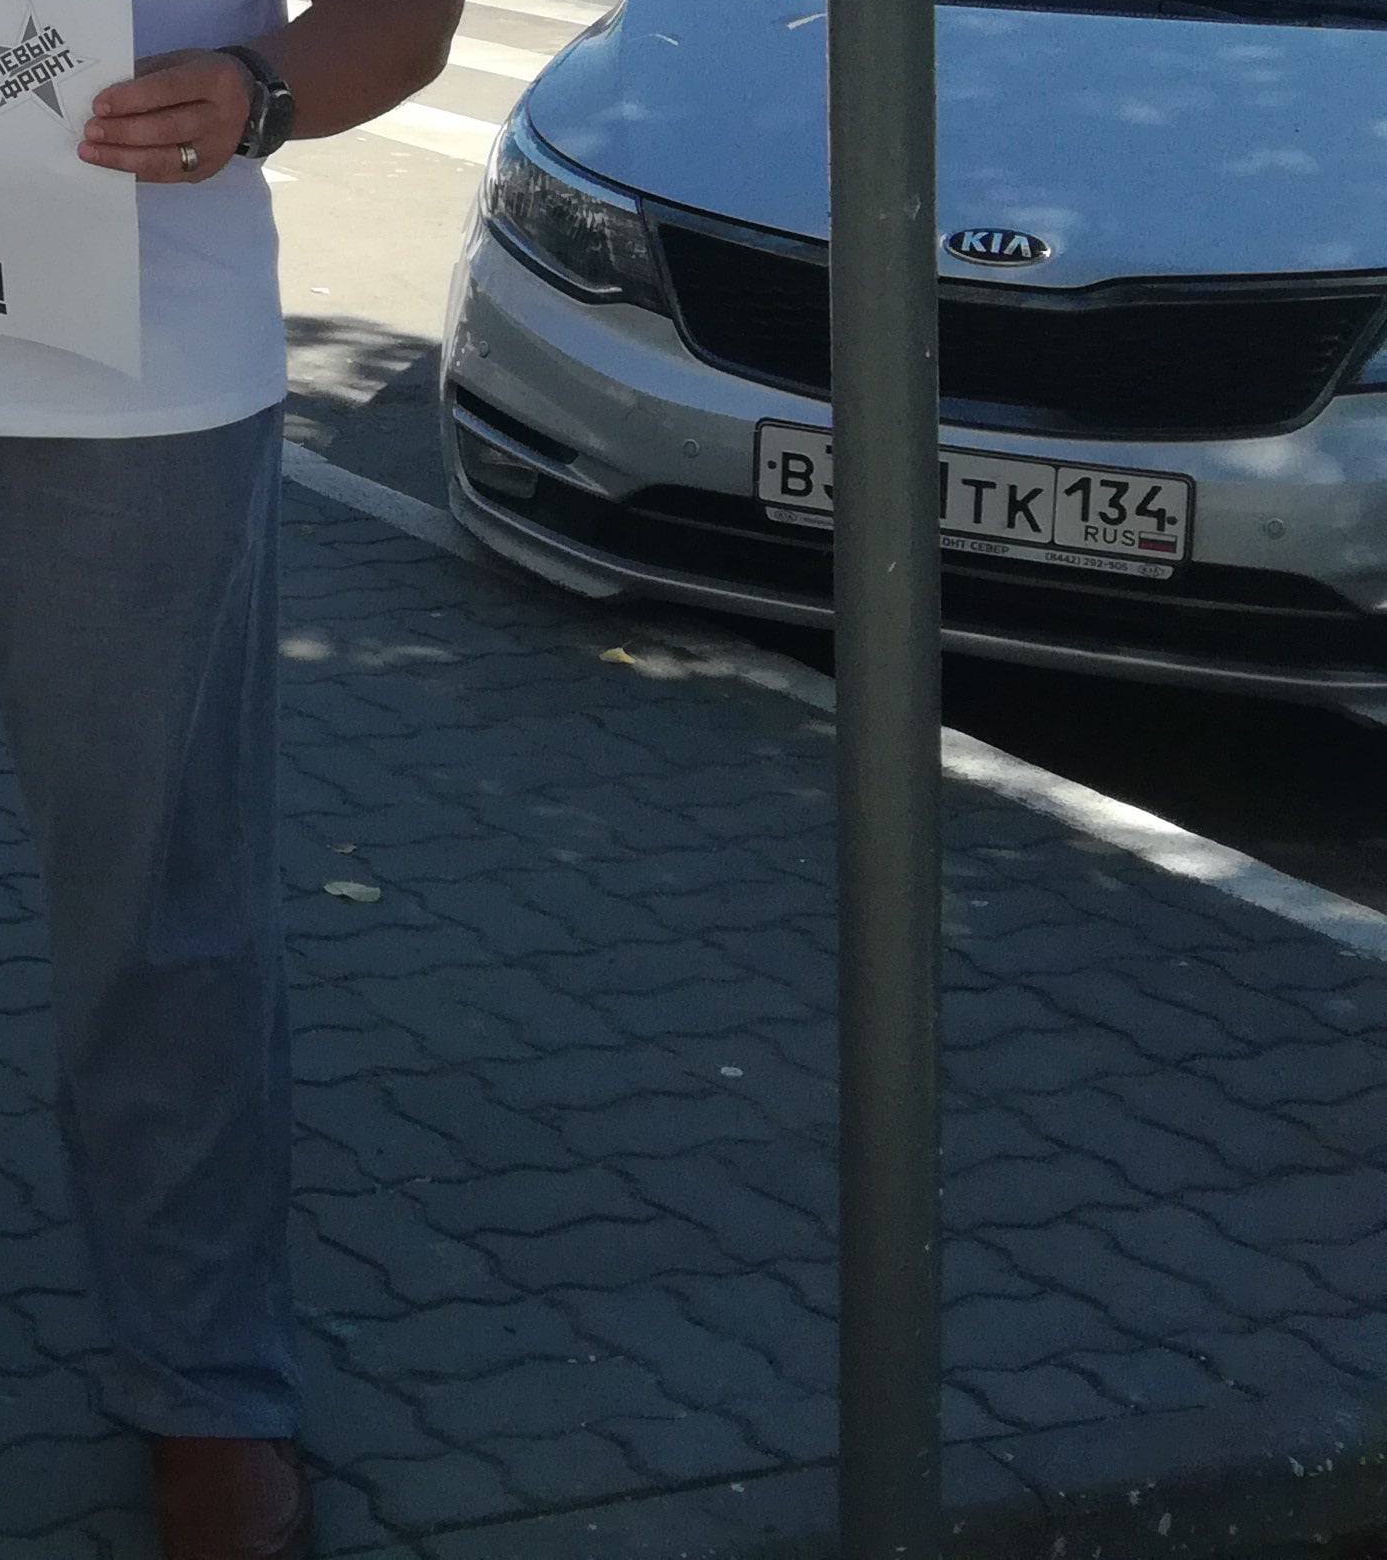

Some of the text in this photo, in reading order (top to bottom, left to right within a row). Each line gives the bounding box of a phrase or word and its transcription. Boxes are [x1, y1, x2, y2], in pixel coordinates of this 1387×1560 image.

[961, 231, 1032, 258] KIA
[1063, 476, 1168, 532] 134
[970, 540, 1010, 555] СЕВЕР
[1084, 525, 1136, 547] RUS
